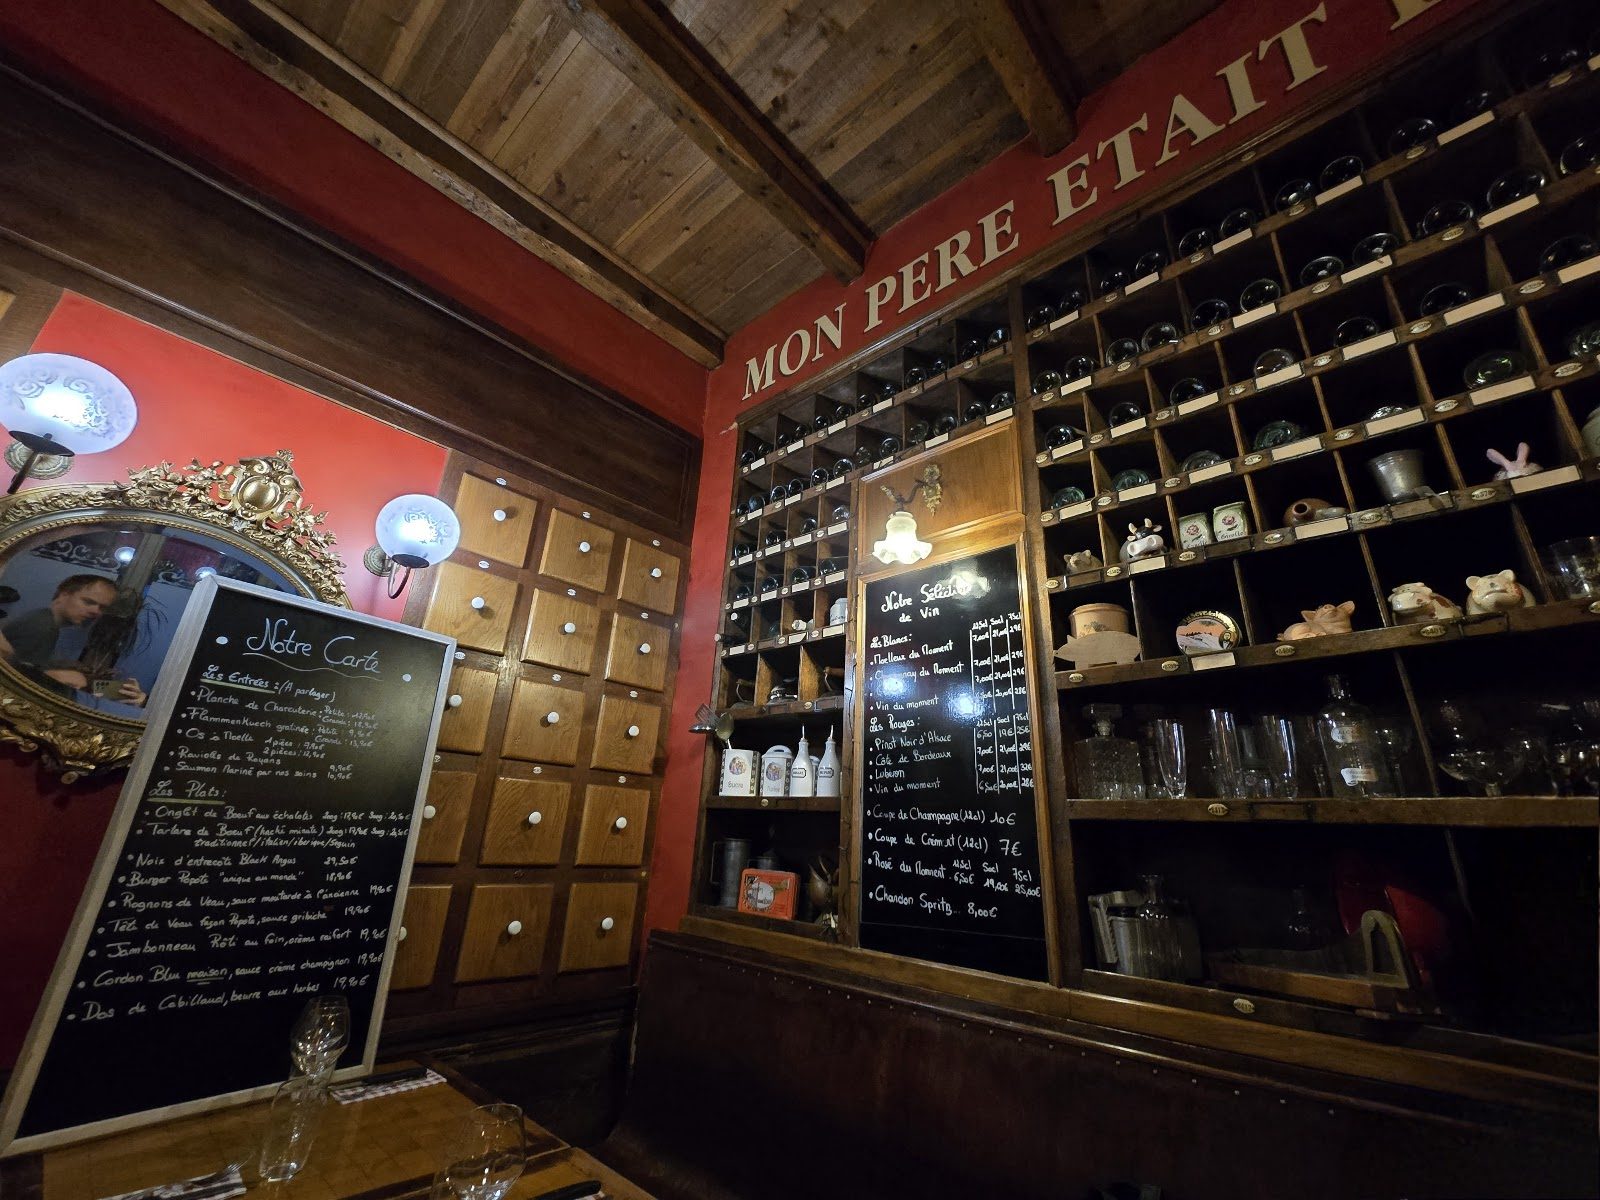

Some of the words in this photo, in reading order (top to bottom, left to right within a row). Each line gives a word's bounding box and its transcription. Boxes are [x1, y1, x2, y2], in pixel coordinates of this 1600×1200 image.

[741, 304, 847, 402] MON
[865, 201, 1021, 335] PERE
[1047, 2, 1329, 227] ETAIT
[881, 590, 913, 613] Notre
[899, 612, 912, 623] de
[920, 606, 940, 619] Vin
[247, 618, 312, 657] Notre
[324, 636, 381, 673] Carte
[909, 650, 920, 660] du
[202, 664, 223, 680] Les
[919, 667, 930, 676] du
[197, 685, 239, 704] Planche
[245, 701, 259, 710] de
[876, 702, 889, 711] Vin
[893, 701, 905, 710] du
[186, 728, 205, 740] Os
[874, 736, 897, 751] Pinot
[900, 734, 917, 747] Noir
[228, 752, 241, 761] de
[898, 754, 909, 763] de
[913, 749, 952, 763] Bordeaux
[149, 780, 173, 796] Les
[874, 782, 889, 794] Vin
[893, 783, 904, 792] du
[204, 809, 217, 818] de
[898, 810, 909, 821] de
[990, 812, 1016, 826] 10€
[197, 827, 209, 836] de
[874, 828, 898, 847] Coupe
[905, 834, 915, 845] de
[999, 838, 1022, 857] 7€
[872, 850, 893, 870] Rosé
[900, 861, 912, 873] du
[125, 871, 172, 887] Burger
[875, 885, 914, 905] Chandon
[967, 902, 999, 918] 8,00€
[93, 969, 144, 987] Cordon
[81, 1001, 115, 1021] Dos
[128, 1002, 146, 1015] de
